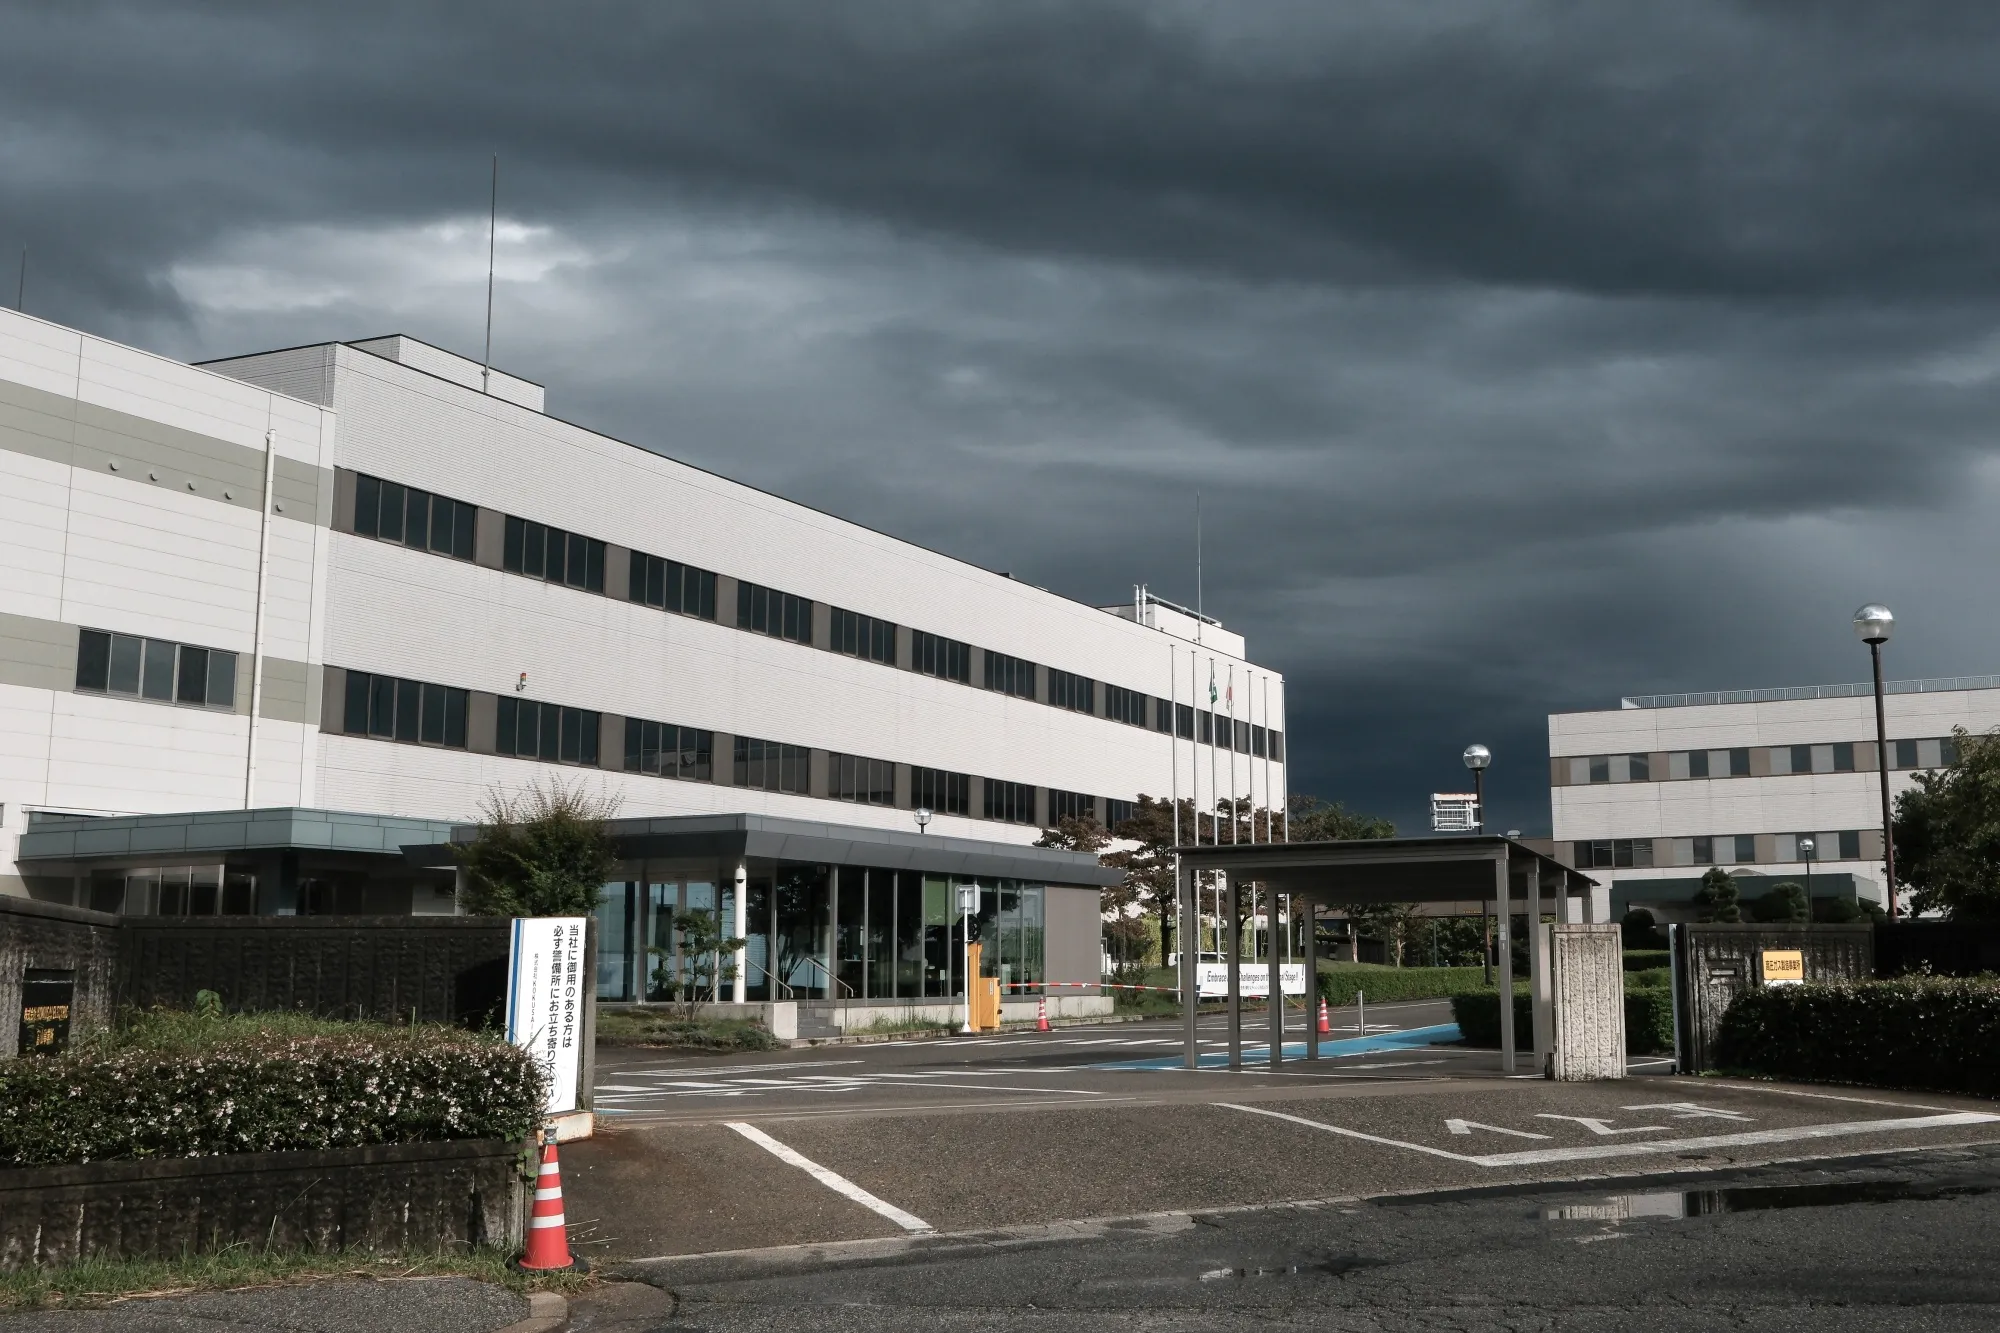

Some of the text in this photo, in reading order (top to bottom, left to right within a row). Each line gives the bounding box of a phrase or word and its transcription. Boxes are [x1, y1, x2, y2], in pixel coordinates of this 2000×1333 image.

[562, 924, 579, 1048] 当社に御用のある方は
[1207, 970, 1227, 983] Embrace
[1240, 972, 1260, 984] hallenges
[1444, 1102, 1758, 1140] トマレ
